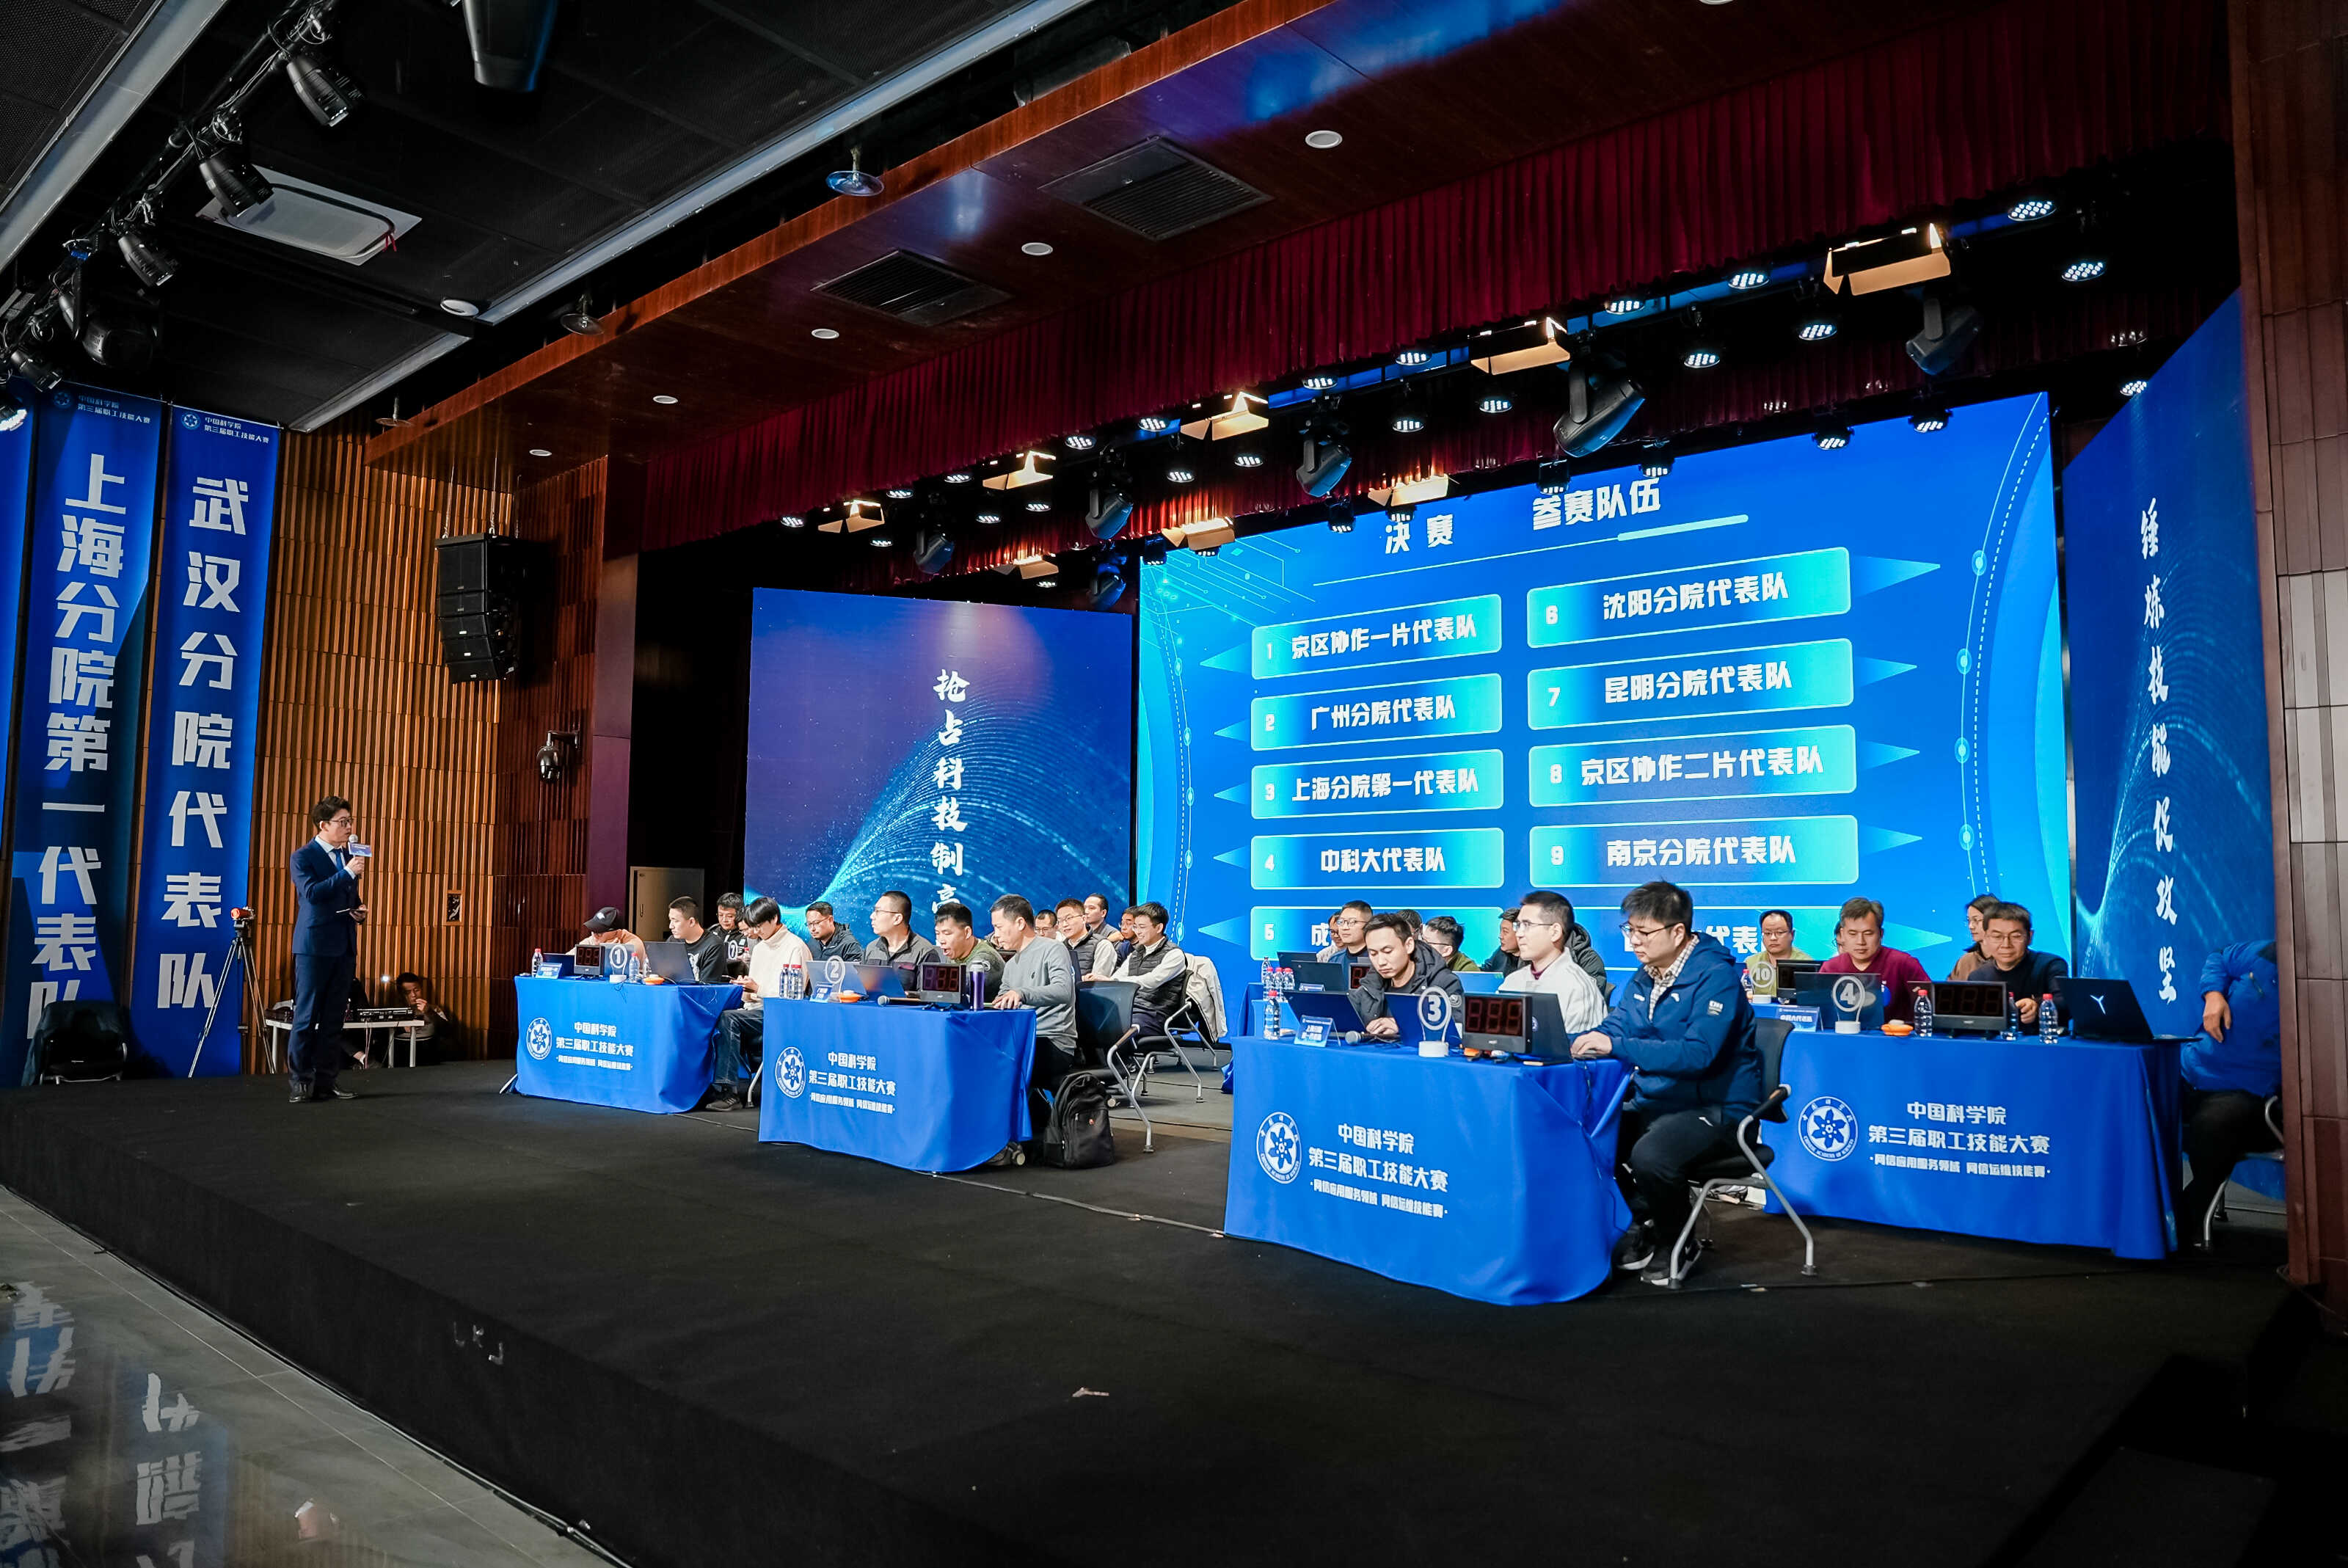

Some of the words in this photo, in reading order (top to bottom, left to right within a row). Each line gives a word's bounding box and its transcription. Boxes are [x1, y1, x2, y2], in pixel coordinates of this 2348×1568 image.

[204, 416, 242, 430] 中国科学院
[204, 424, 270, 444] 第三届职工技能大赛
[1532, 477, 1661, 531] 参赛队伍
[1546, 605, 1558, 624] 6
[1603, 571, 1789, 621] 沈阳分院代表队
[1266, 642, 1273, 660] 1
[1291, 613, 1477, 660] 京区协作一片代表队
[1548, 687, 1561, 707] 7
[1605, 661, 1793, 704] 昆明分院代表队
[1266, 714, 1275, 731] 2
[1310, 694, 1456, 731] 广州分院代表队
[157, 476, 249, 1010] 武汉分院代表队
[1550, 764, 1563, 784] 8
[1580, 745, 1825, 787] 京区协作二片代表队
[1266, 784, 1275, 801] 3
[1291, 767, 1479, 803] 上海分院第一代表队
[1265, 854, 1275, 871] 4
[1321, 846, 1445, 873] 中科大代表队
[1550, 845, 1564, 866] 9
[1607, 835, 1796, 867] 南京分院代表队
[1265, 923, 1275, 941] 5
[830, 960, 840, 978] 2
[1755, 968, 1771, 981] 10
[1840, 982, 1856, 1005] 4
[1427, 994, 1442, 1022] 3
[574, 1021, 617, 1038] 中国科学院
[555, 1037, 634, 1057] 第三届职工技能大赛
[828, 1051, 877, 1071] 中国科学院
[809, 1069, 897, 1096] 第三届职工技能大赛
[1906, 1101, 2007, 1126] 中国科学院
[1338, 1123, 1415, 1155] 中国科学院
[1868, 1124, 2051, 1156] 第三届职工技能大赛
[1308, 1146, 1449, 1193] 第三届职工技能大赛
